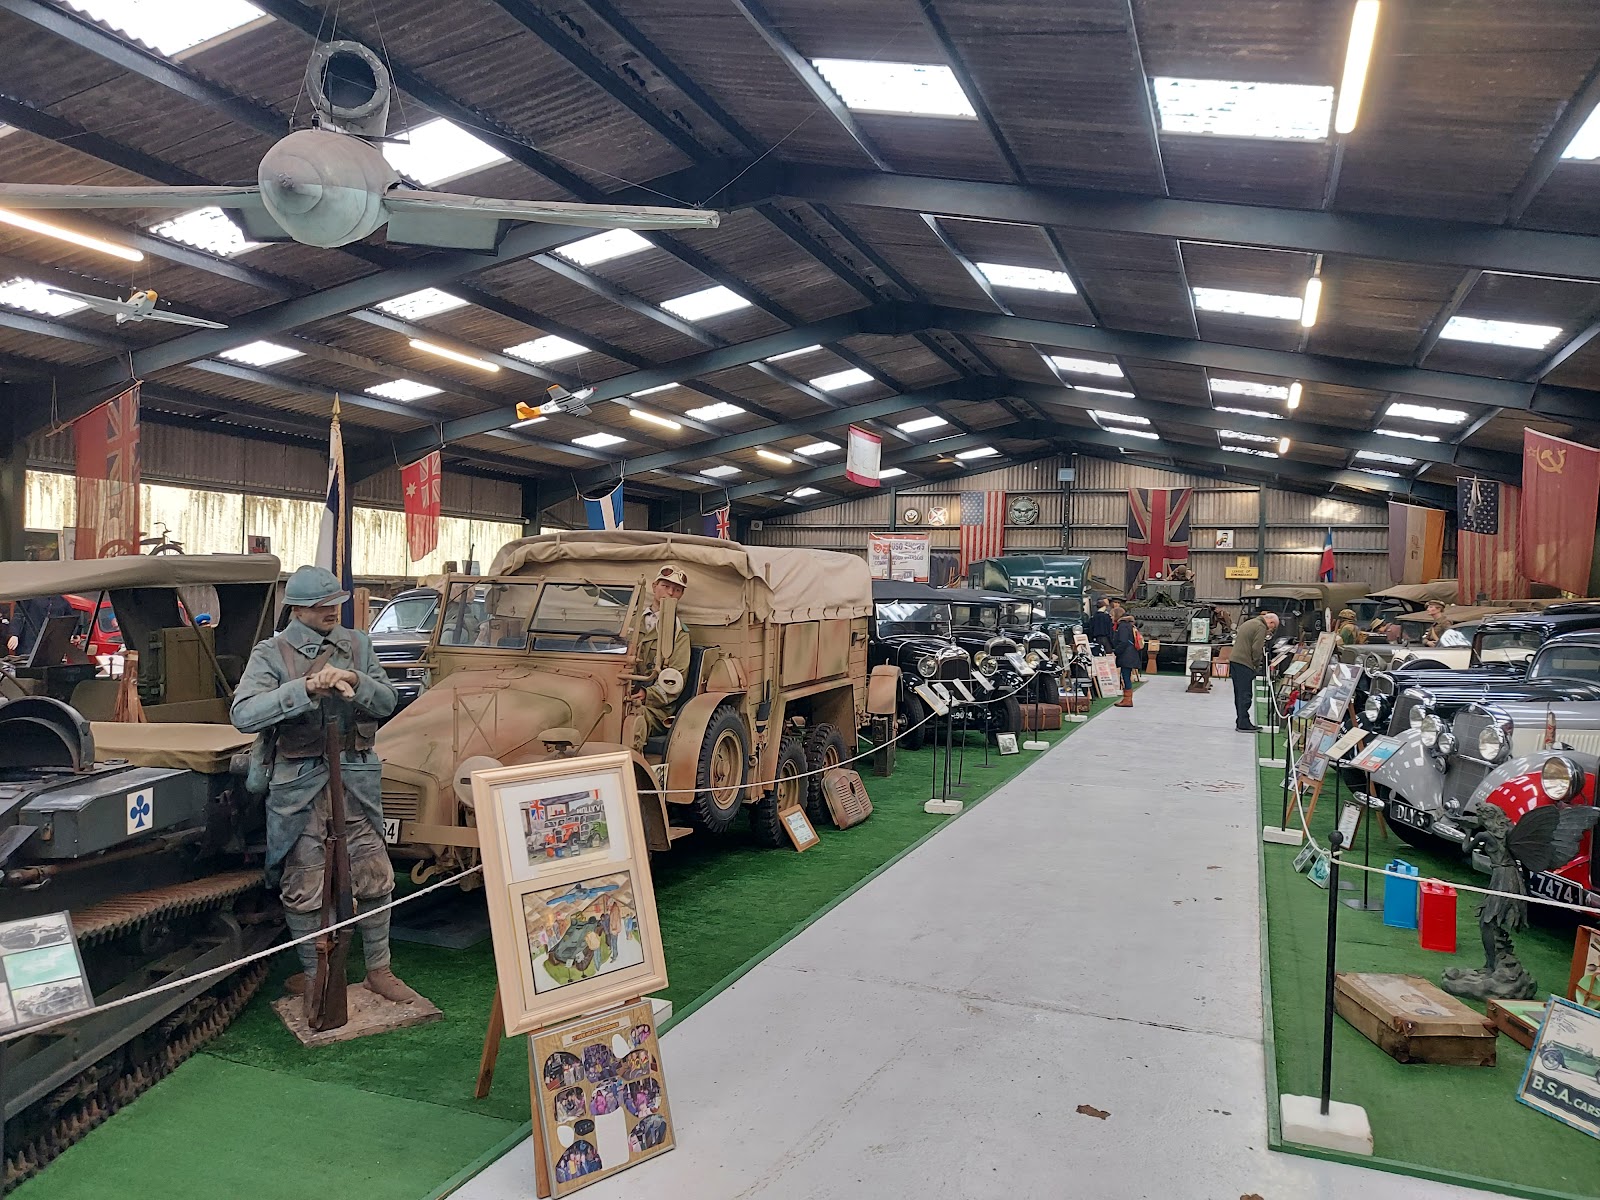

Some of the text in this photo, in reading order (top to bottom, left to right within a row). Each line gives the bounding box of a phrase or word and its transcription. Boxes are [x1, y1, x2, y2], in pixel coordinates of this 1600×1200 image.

[1396, 804, 1417, 824] DLY
[1532, 1074, 1600, 1118] B.S.A. CARS
